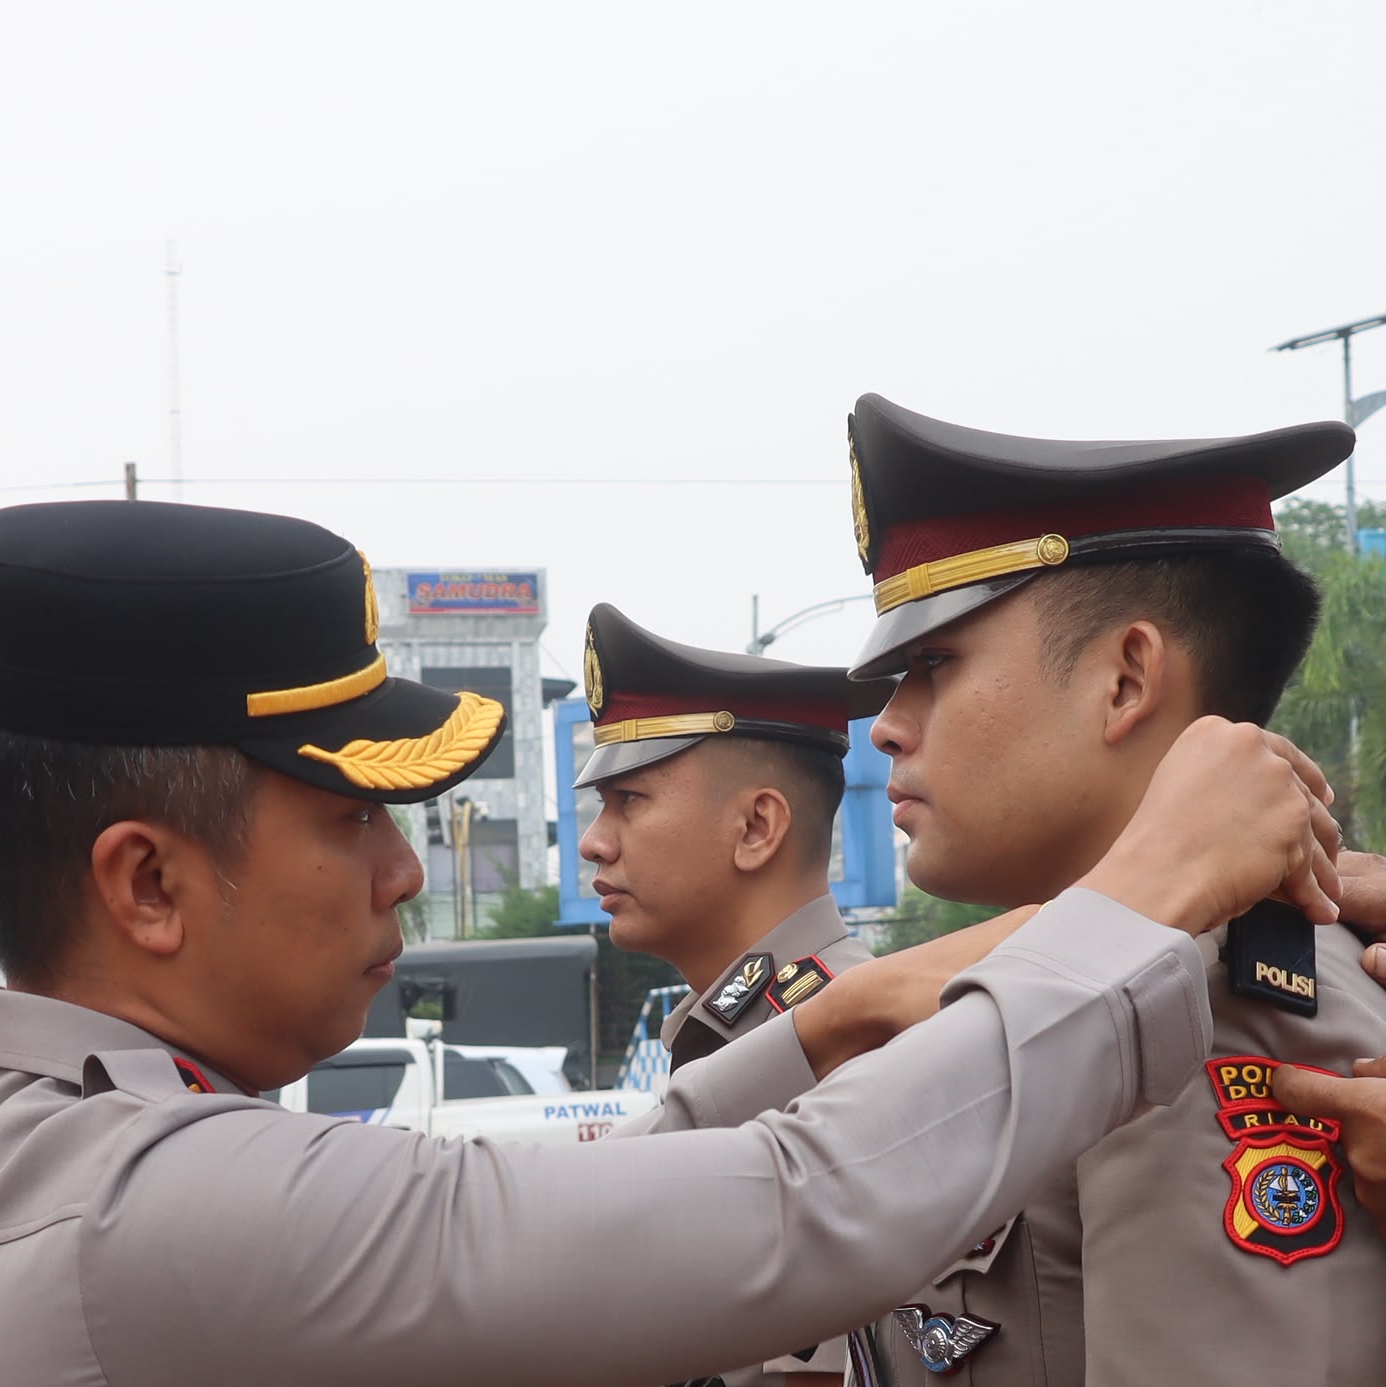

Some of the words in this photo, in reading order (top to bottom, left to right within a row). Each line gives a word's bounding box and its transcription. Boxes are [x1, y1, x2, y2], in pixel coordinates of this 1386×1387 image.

[417, 582, 532, 600] SAMUDRA
[1256, 961, 1315, 998] POLISI
[544, 1102, 628, 1119] PATWAL
[1244, 1112, 1323, 1131] RIAU
